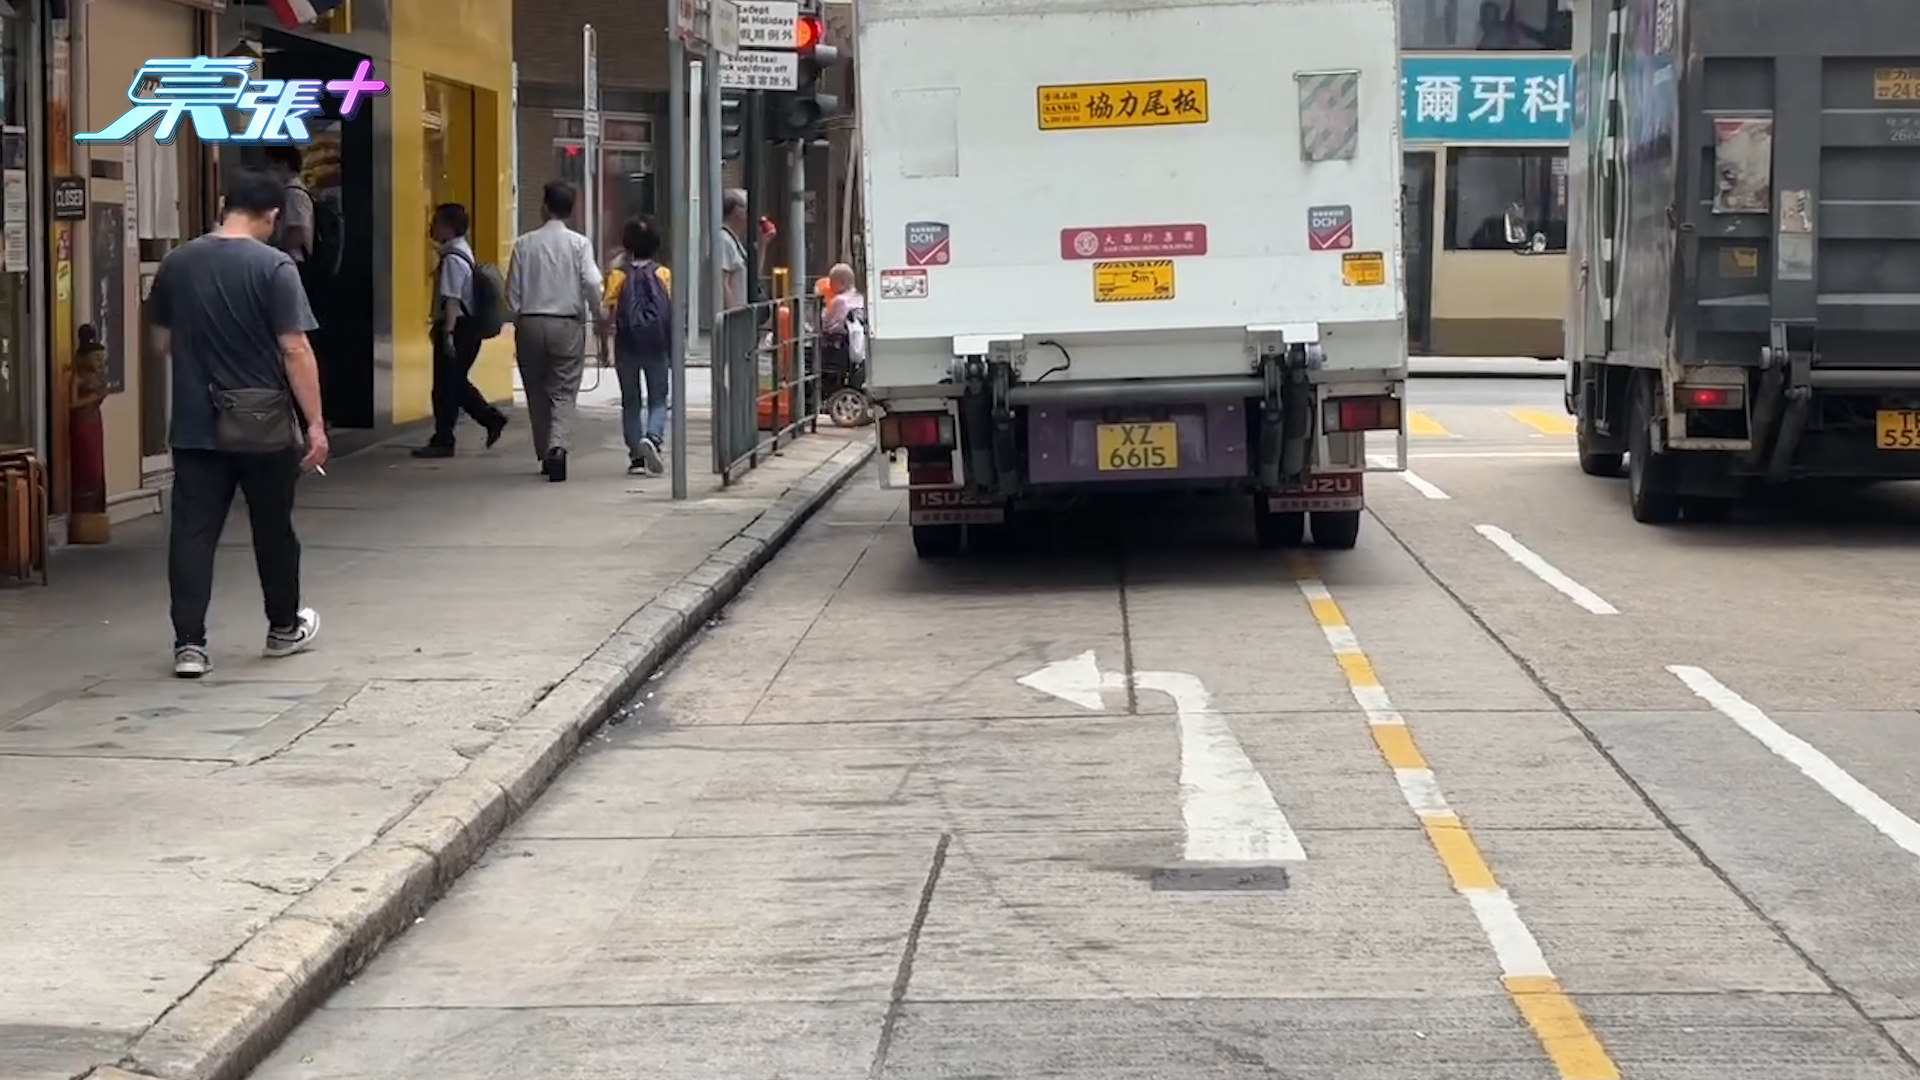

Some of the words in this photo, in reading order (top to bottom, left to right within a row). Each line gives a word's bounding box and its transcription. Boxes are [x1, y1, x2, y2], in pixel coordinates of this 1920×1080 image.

[752, 17, 793, 27] Holidays
[760, 55, 778, 64] taxi
[737, 64, 772, 74] up/drop
[774, 64, 789, 72] off
[1085, 89, 1202, 119] 協力尾板
[1401, 74, 1571, 123] 爾牙科
[55, 189, 84, 207] CLOSED
[1312, 217, 1337, 228] DCH
[910, 233, 934, 244] DCH
[1131, 270, 1150, 283] 5m
[1121, 425, 1153, 446] XZ
[1110, 447, 1166, 468] 6615
